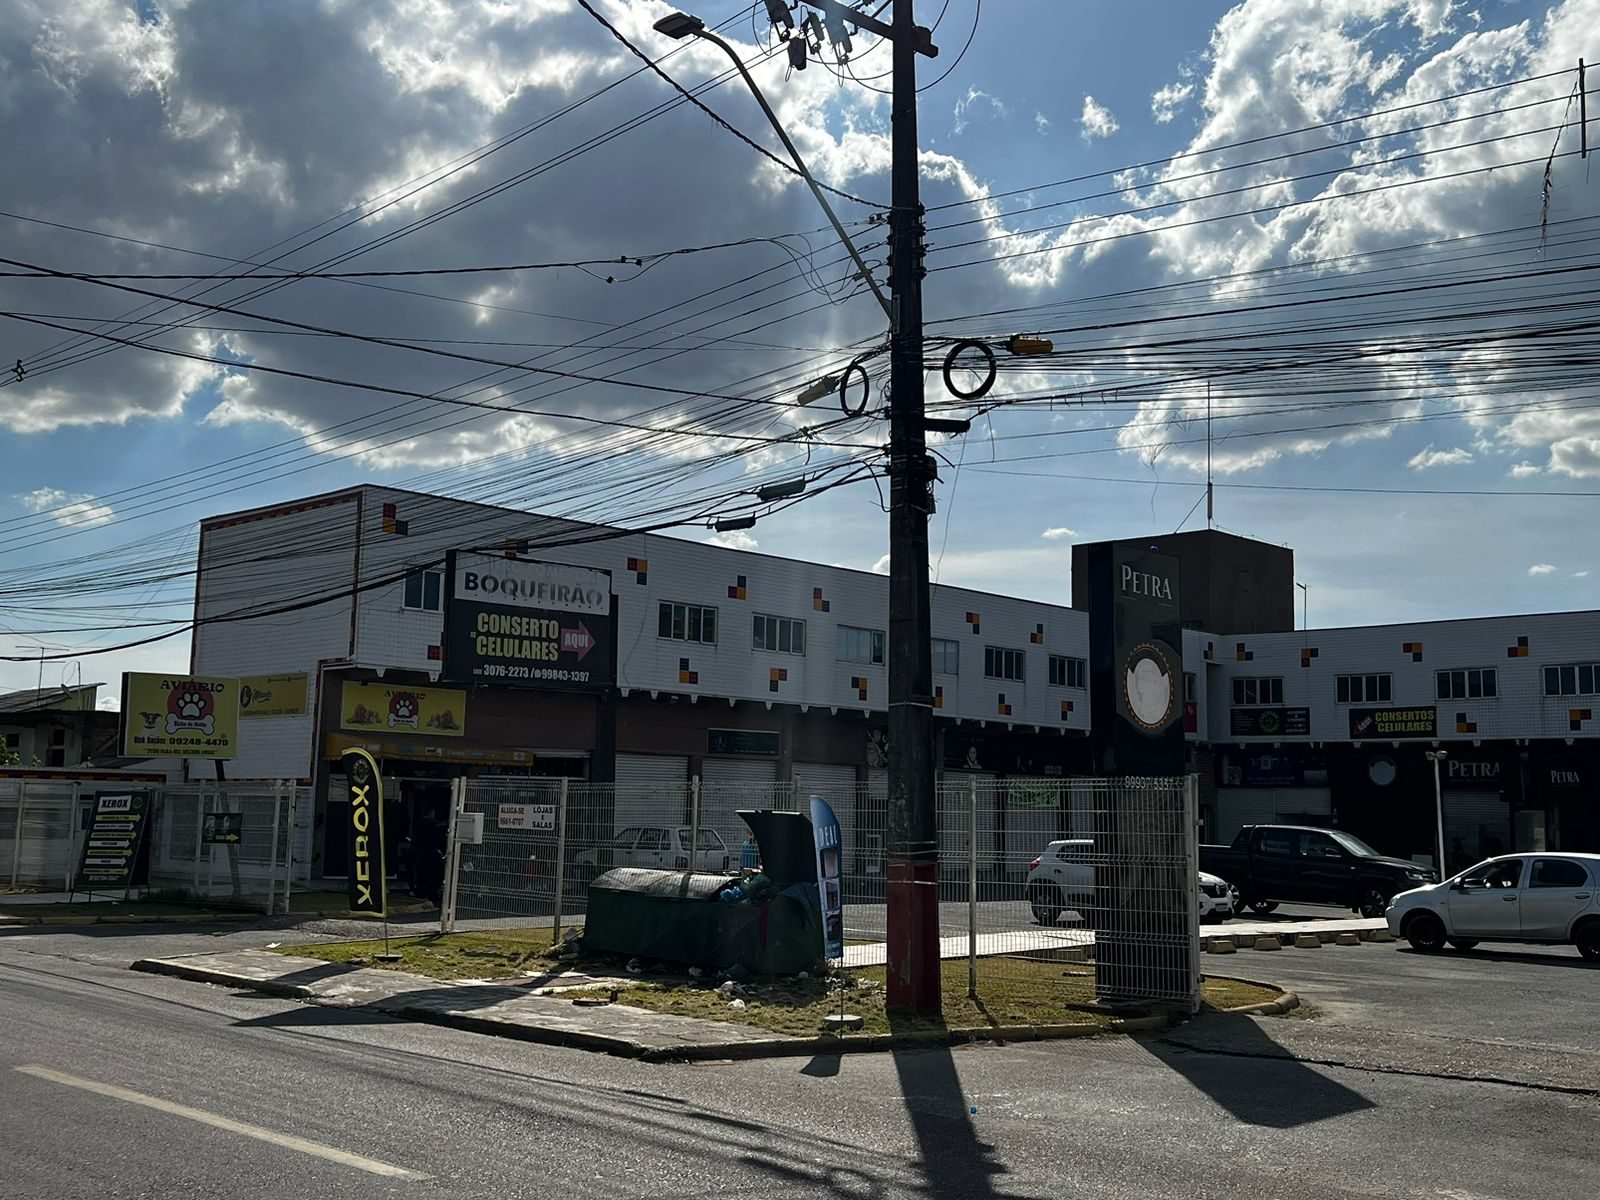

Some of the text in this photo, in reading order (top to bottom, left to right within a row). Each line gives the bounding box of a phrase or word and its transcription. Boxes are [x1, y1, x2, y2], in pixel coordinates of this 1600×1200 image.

[1121, 564, 1173, 600] PETRA
[477, 612, 560, 640] CONSERTO
[476, 635, 560, 662] CELULARES
[564, 633, 589, 649] AQUI
[484, 664, 529, 678] 3076-2273
[541, 669, 590, 683] 99843-1397
[160, 679, 225, 693] AVIÁRIO
[1375, 710, 1435, 723] CONSERTOS
[1377, 721, 1433, 733] CELULARES
[169, 737, 228, 747] 99248-4470
[1448, 760, 1501, 777] PETRA
[1550, 768, 1580, 785] PETRA
[101, 799, 128, 809] XEROX
[533, 806, 554, 814] LOJAS
[532, 821, 553, 829] SALAS
[352, 784, 373, 905] XEROX
